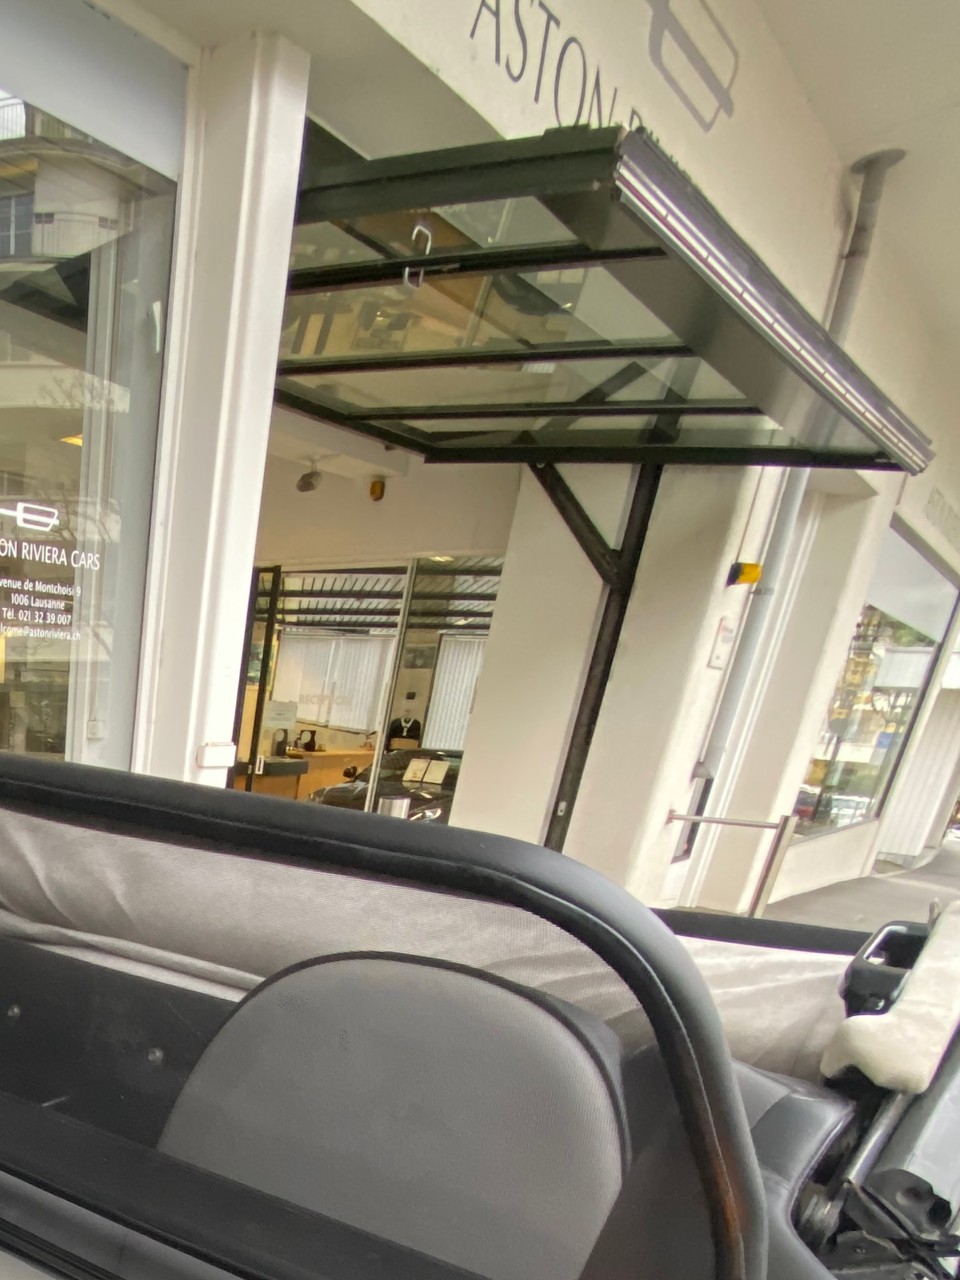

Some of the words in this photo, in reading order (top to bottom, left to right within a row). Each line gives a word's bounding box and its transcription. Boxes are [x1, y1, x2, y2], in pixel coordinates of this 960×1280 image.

[21, 542, 67, 567] RIVIERA
[71, 550, 100, 570] CARS
[23, 578, 34, 590] de
[35, 580, 75, 596] Montchoisi
[76, 585, 82, 597] 9
[11, 592, 29, 606] 1006
[31, 596, 66, 610] Lausanne
[2, 607, 17, 620] Tél.
[18, 611, 31, 622] 021
[34, 611, 44, 623] 32
[46, 612, 56, 625] 39
[57, 613, 71, 625] 007
